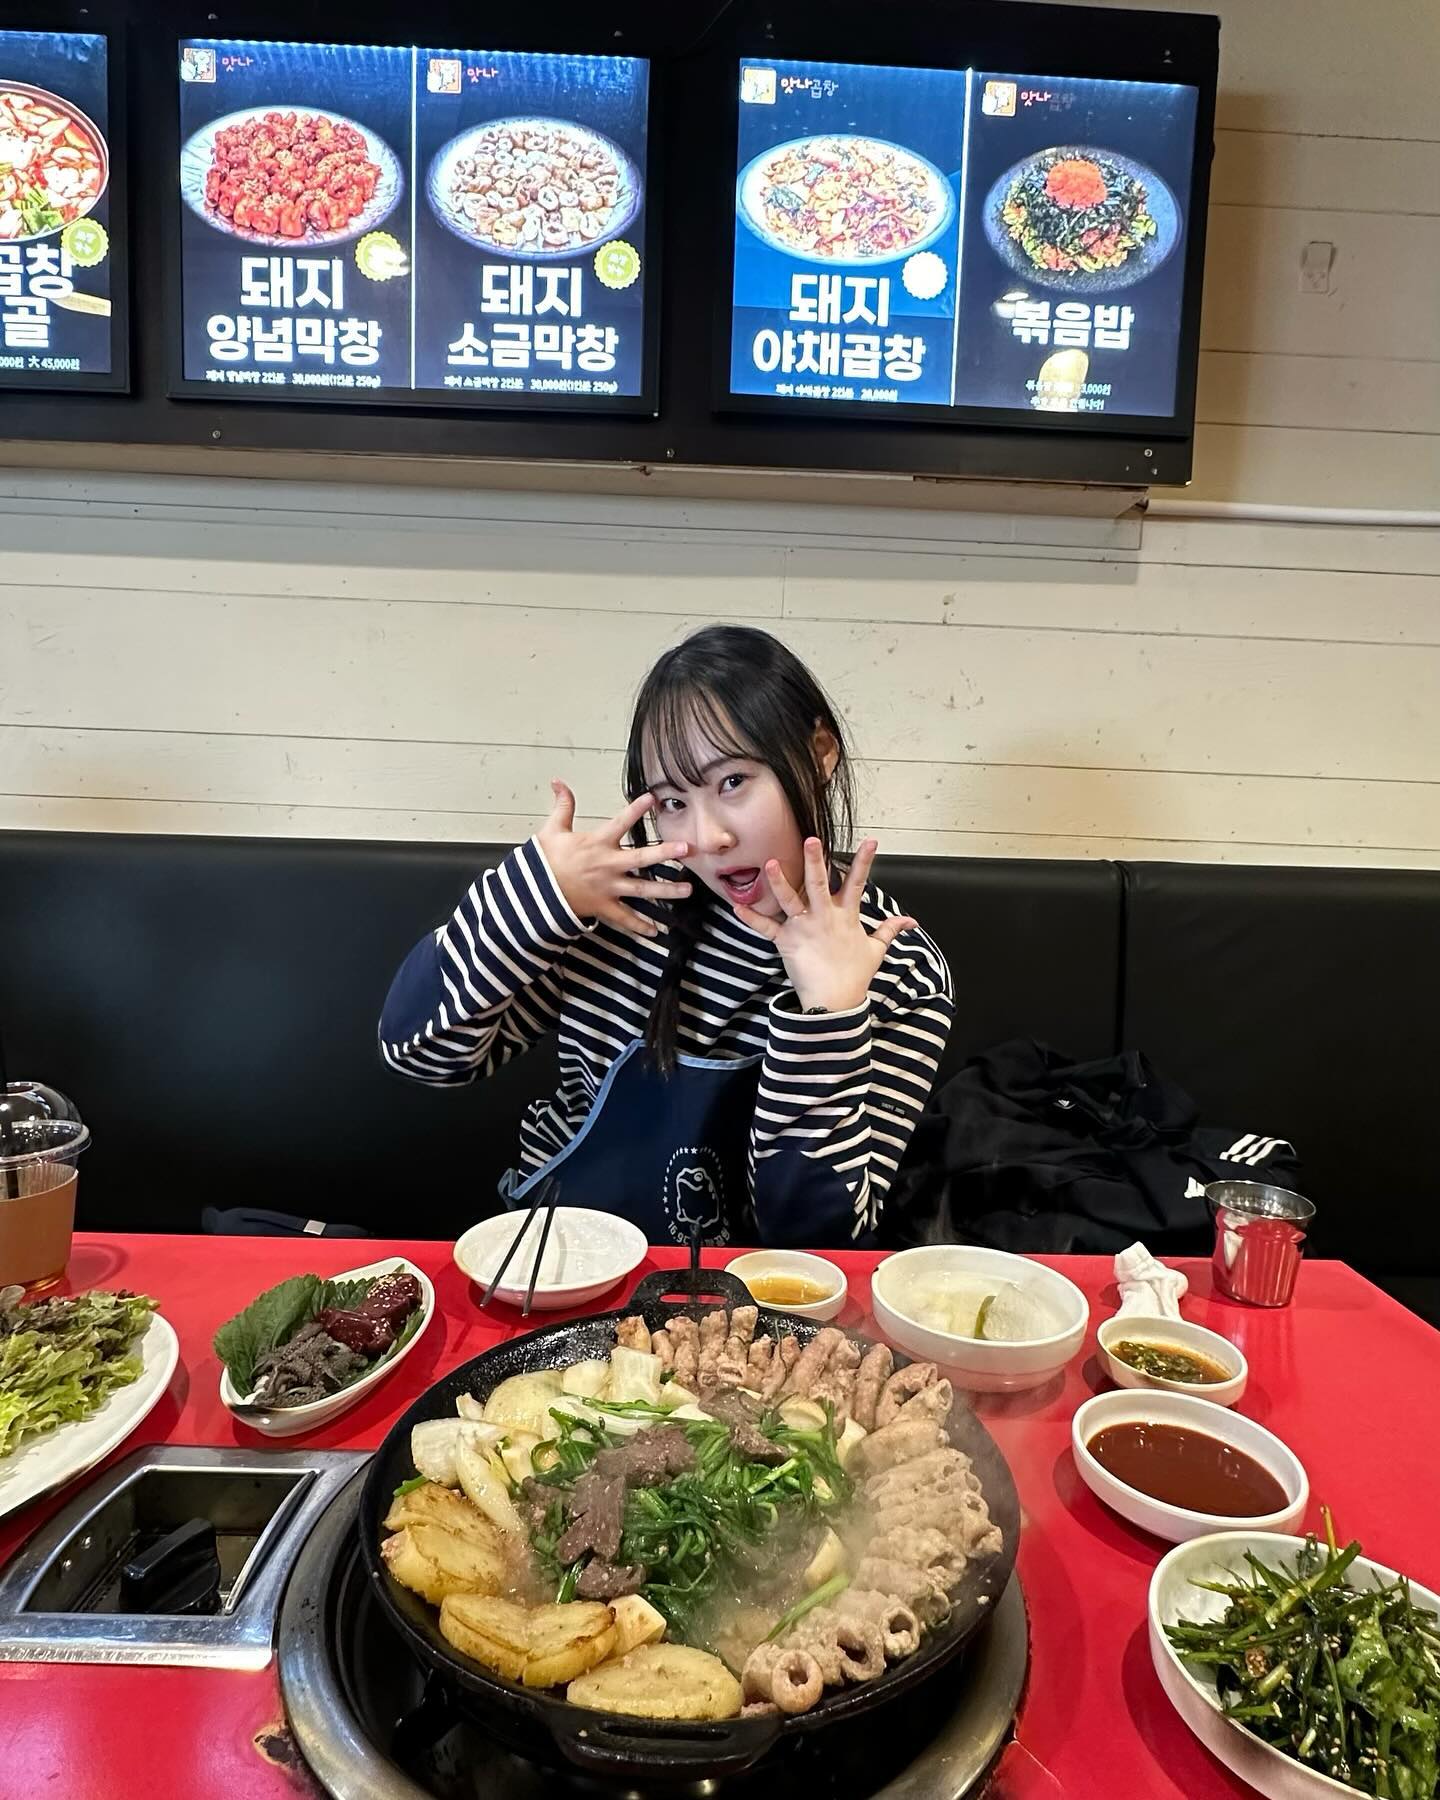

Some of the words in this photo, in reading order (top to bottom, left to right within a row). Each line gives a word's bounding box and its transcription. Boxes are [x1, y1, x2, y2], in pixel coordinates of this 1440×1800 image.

[241, 256, 344, 310] 돼지
[481, 264, 583, 318] 돼지
[789, 273, 891, 328] 돼지
[206, 314, 383, 366] 양념막창
[447, 322, 620, 372] 소금막창
[1011, 300, 1136, 350] 볶음밥
[41, 358, 81, 371] 45,000원
[752, 328, 927, 382] 야채곱창
